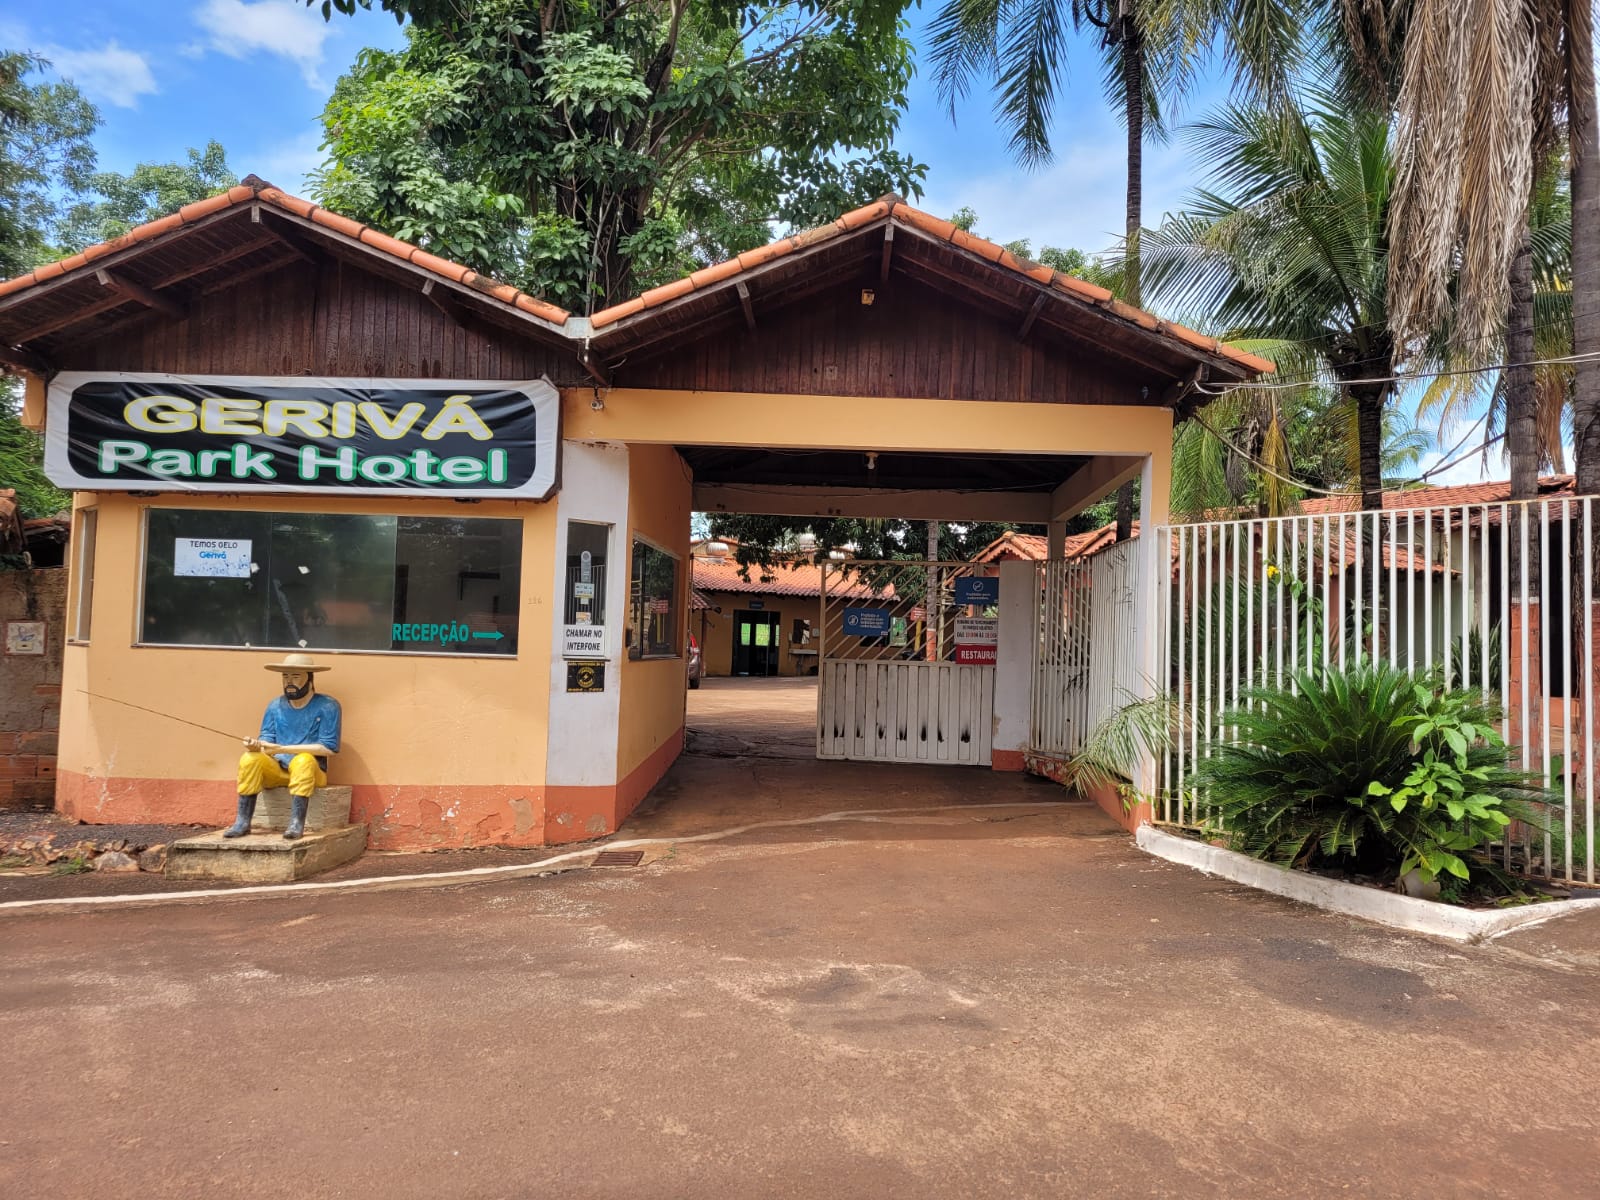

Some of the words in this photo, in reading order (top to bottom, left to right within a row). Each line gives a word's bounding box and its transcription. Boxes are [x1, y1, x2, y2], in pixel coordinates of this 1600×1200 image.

[123, 395, 494, 441] GERIVÁ
[100, 440, 277, 480] Park
[298, 445, 507, 484] Hotel
[392, 620, 469, 646] RECEPÇÃO
[565, 629, 592, 638] CHAMAR
[593, 630, 603, 639] NO
[566, 642, 600, 651] INTERFONE
